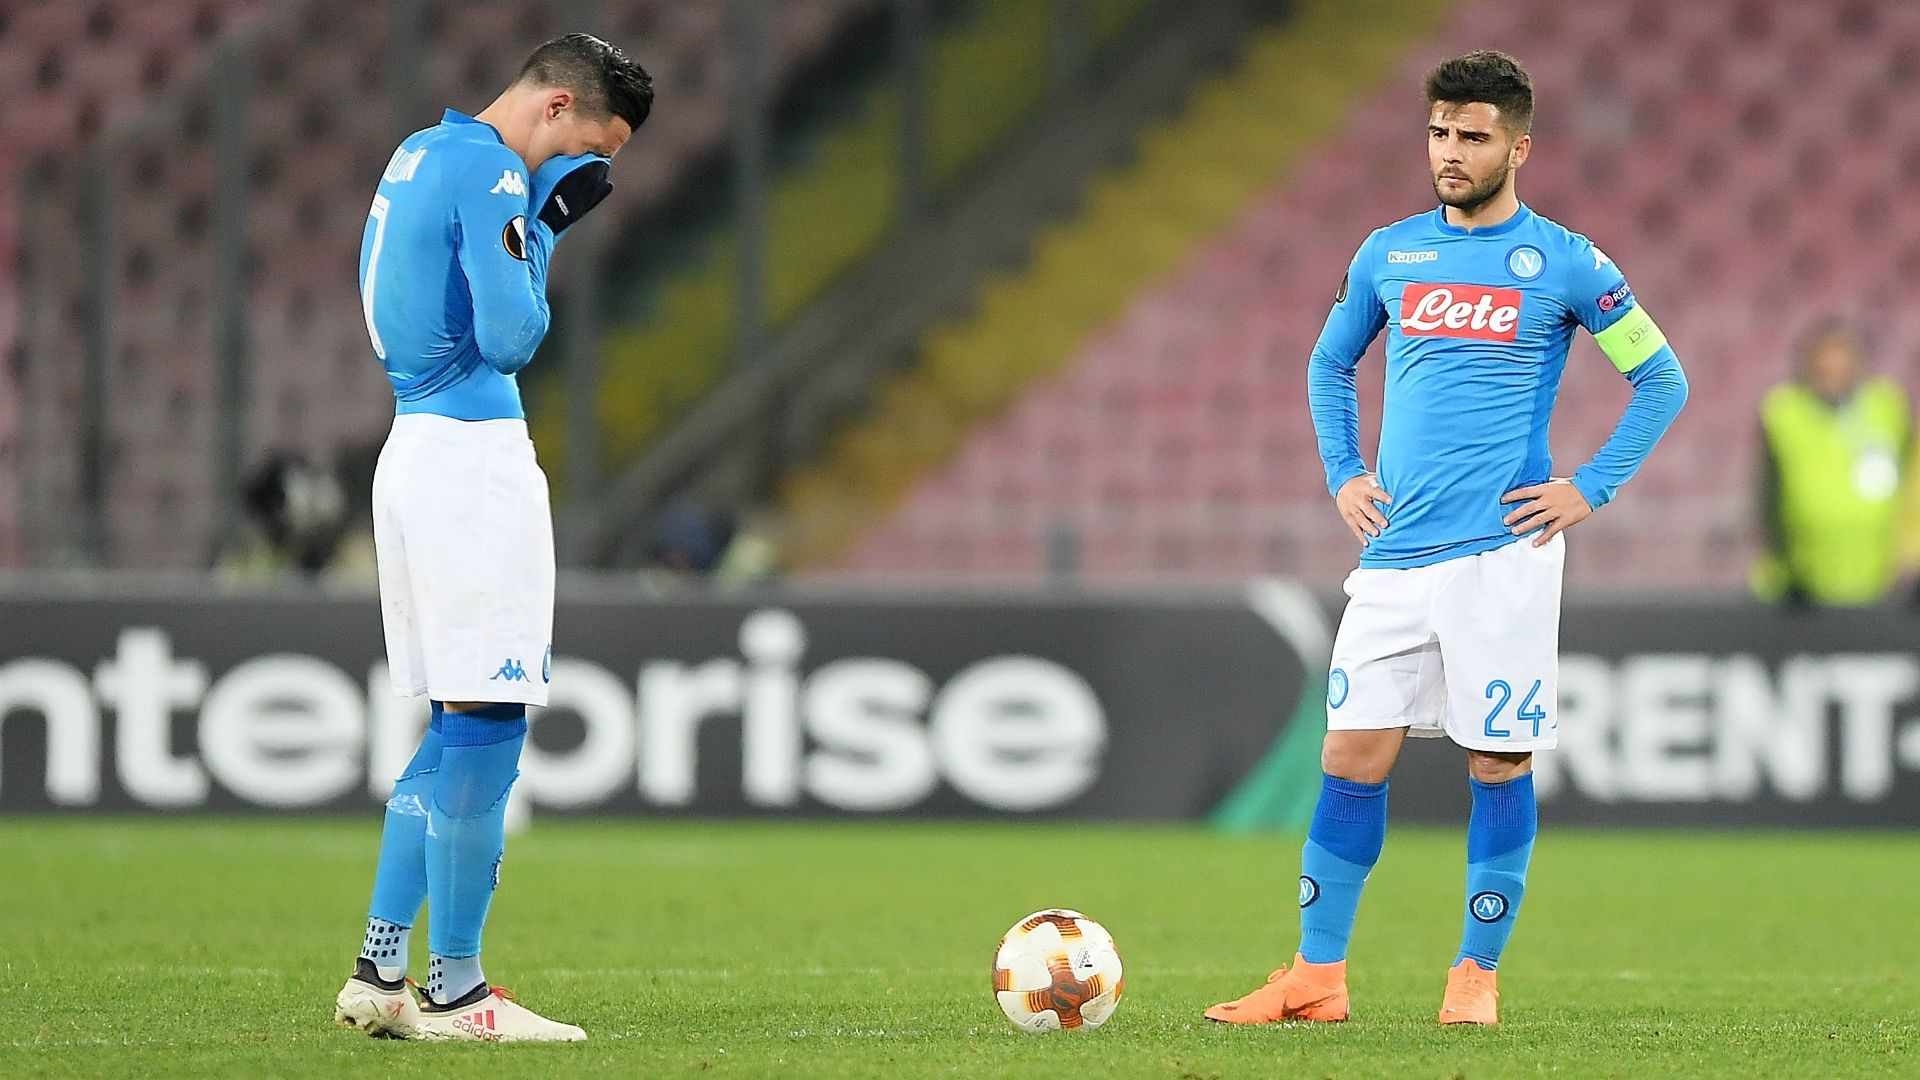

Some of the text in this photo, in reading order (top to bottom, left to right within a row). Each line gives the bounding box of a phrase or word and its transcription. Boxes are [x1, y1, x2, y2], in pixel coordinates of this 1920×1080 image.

[1389, 251, 1437, 263] Kappa
[1517, 252, 1536, 273] N
[1400, 288, 1519, 333] Lete
[1484, 679, 1546, 737] 24
[1478, 898, 1498, 914] N
[452, 1019, 503, 1041] adidas
